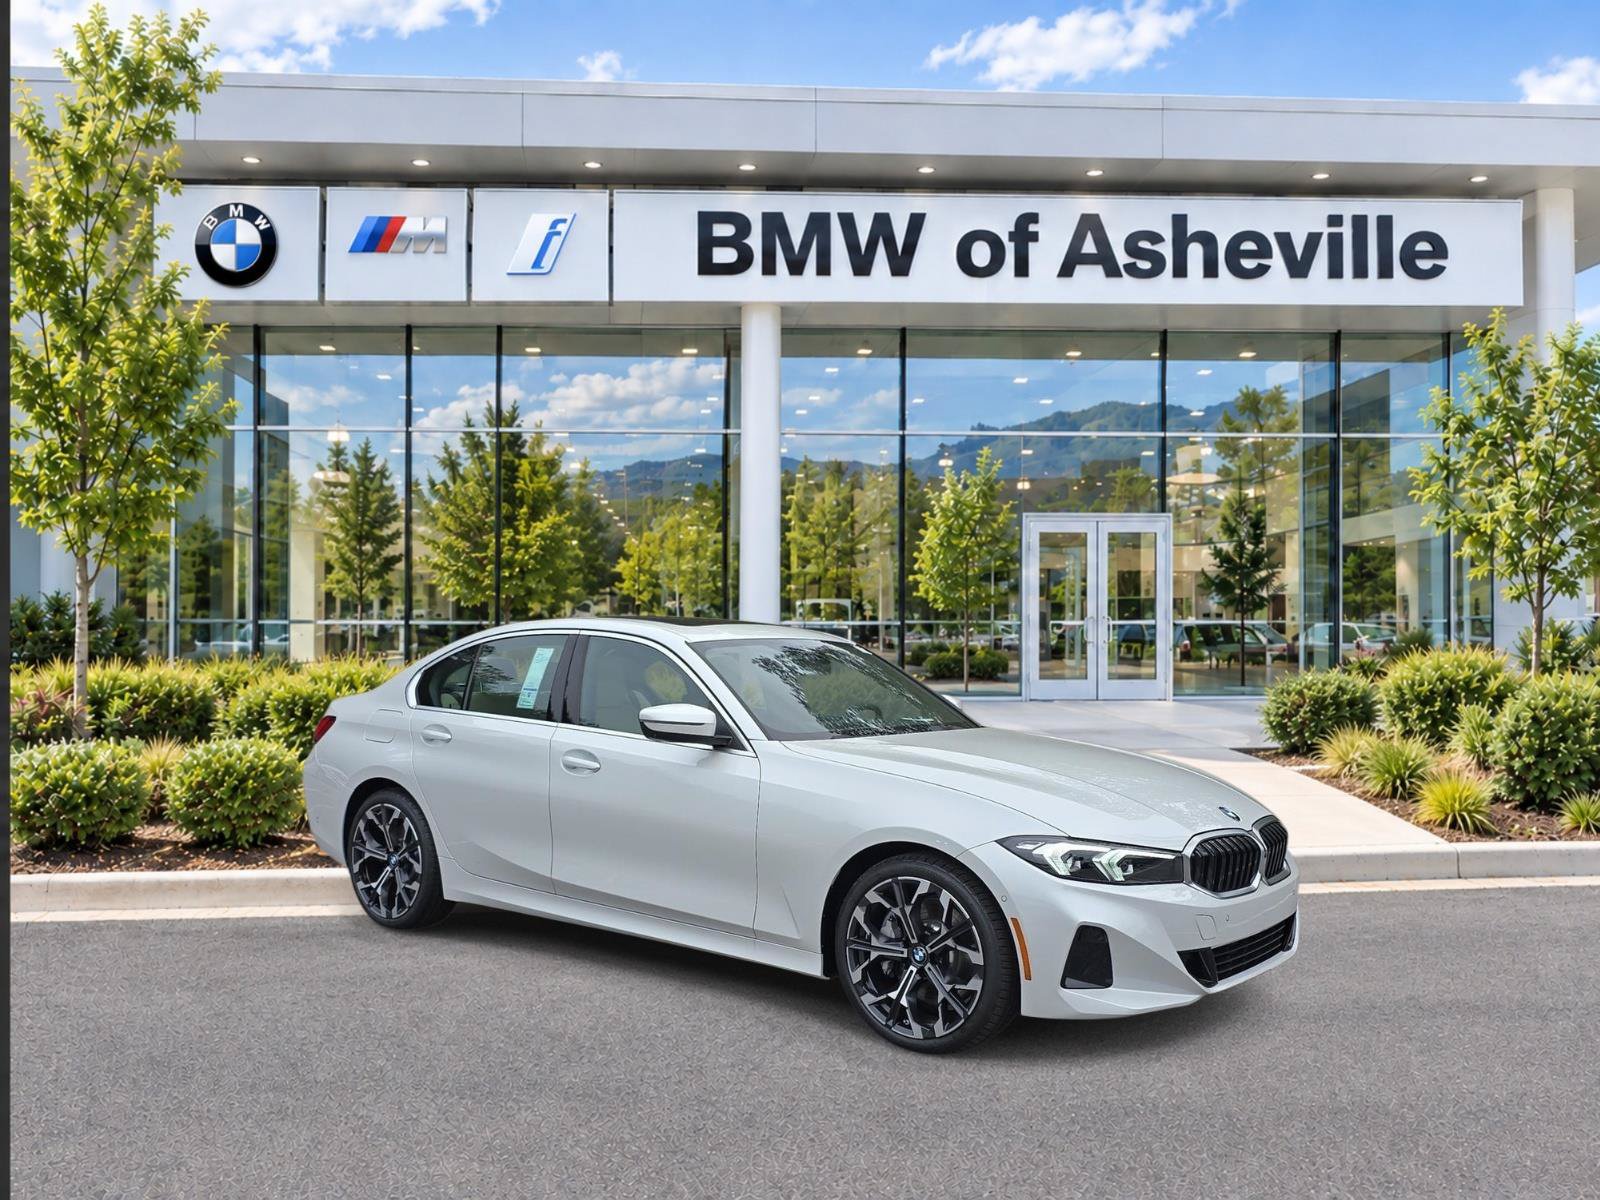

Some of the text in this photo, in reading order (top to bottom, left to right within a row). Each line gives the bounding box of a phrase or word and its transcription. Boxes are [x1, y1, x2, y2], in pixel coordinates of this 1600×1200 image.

[202, 203, 271, 231] BMW
[388, 215, 448, 254] M
[697, 210, 1449, 281] BMW of Asheville
